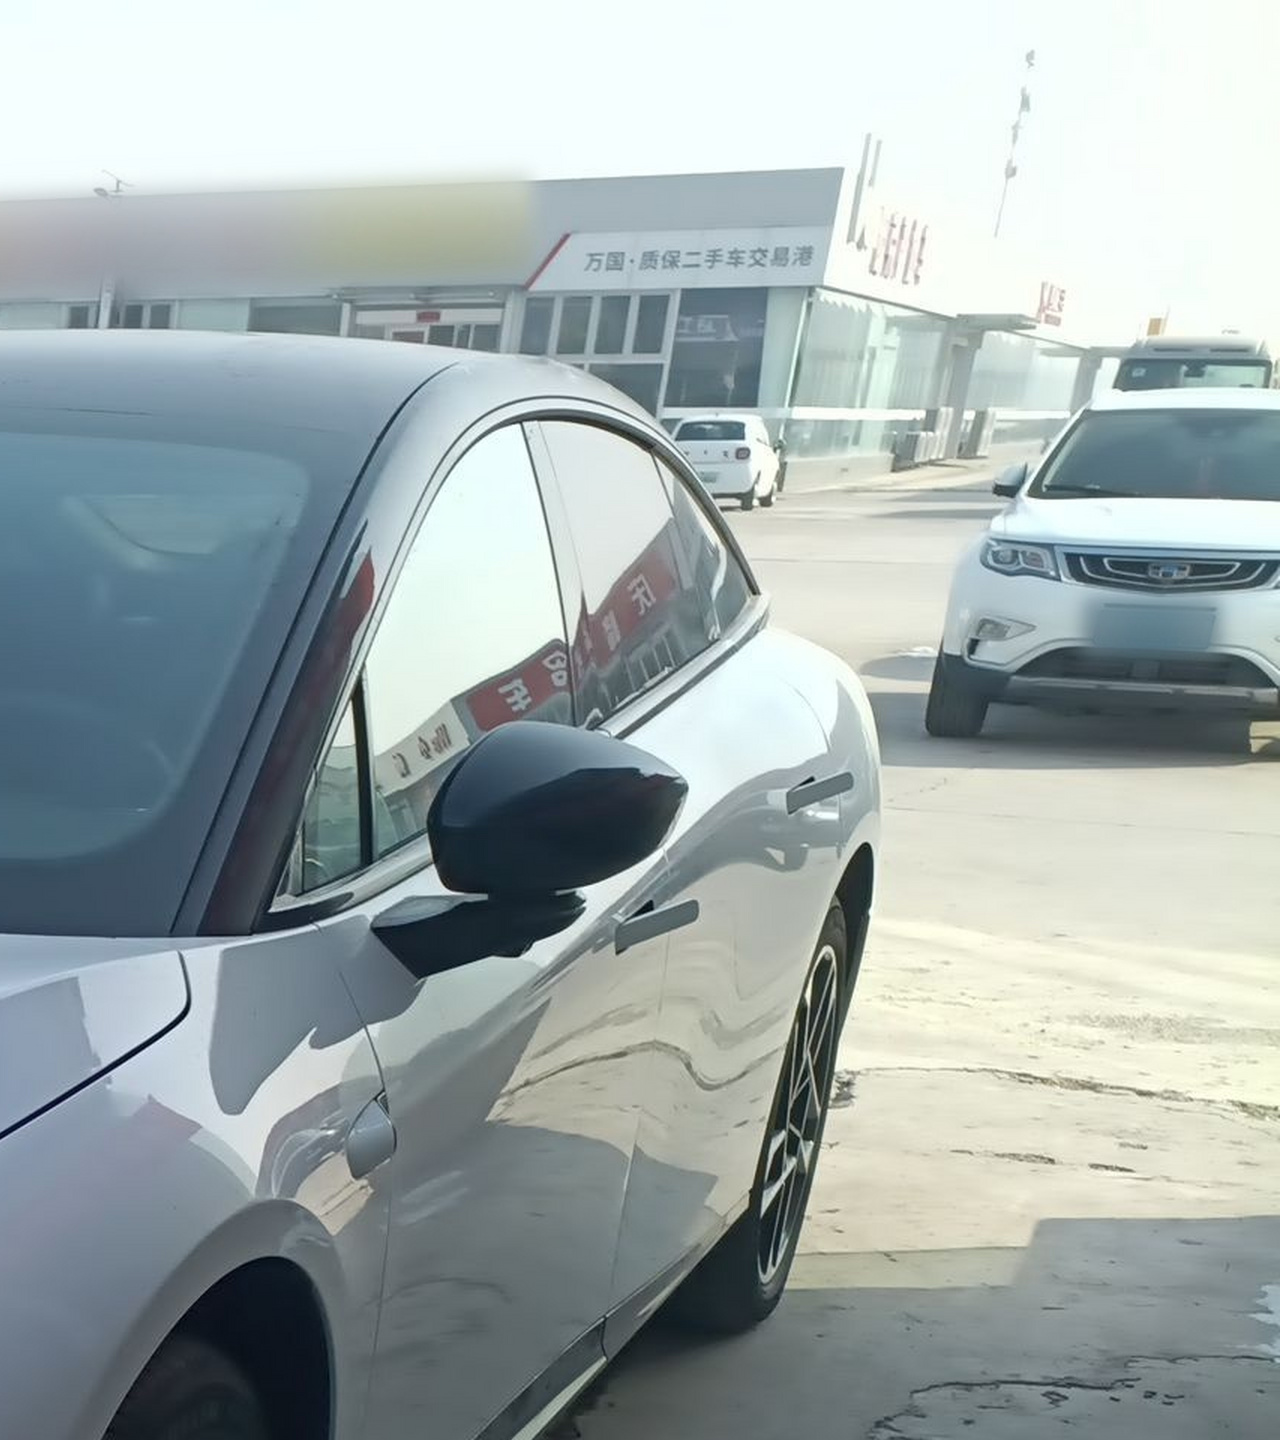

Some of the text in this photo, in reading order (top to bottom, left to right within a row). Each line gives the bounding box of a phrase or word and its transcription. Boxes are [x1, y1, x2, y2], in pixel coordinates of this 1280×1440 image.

[584, 246, 815, 272] 万国·质保二手车交易港
